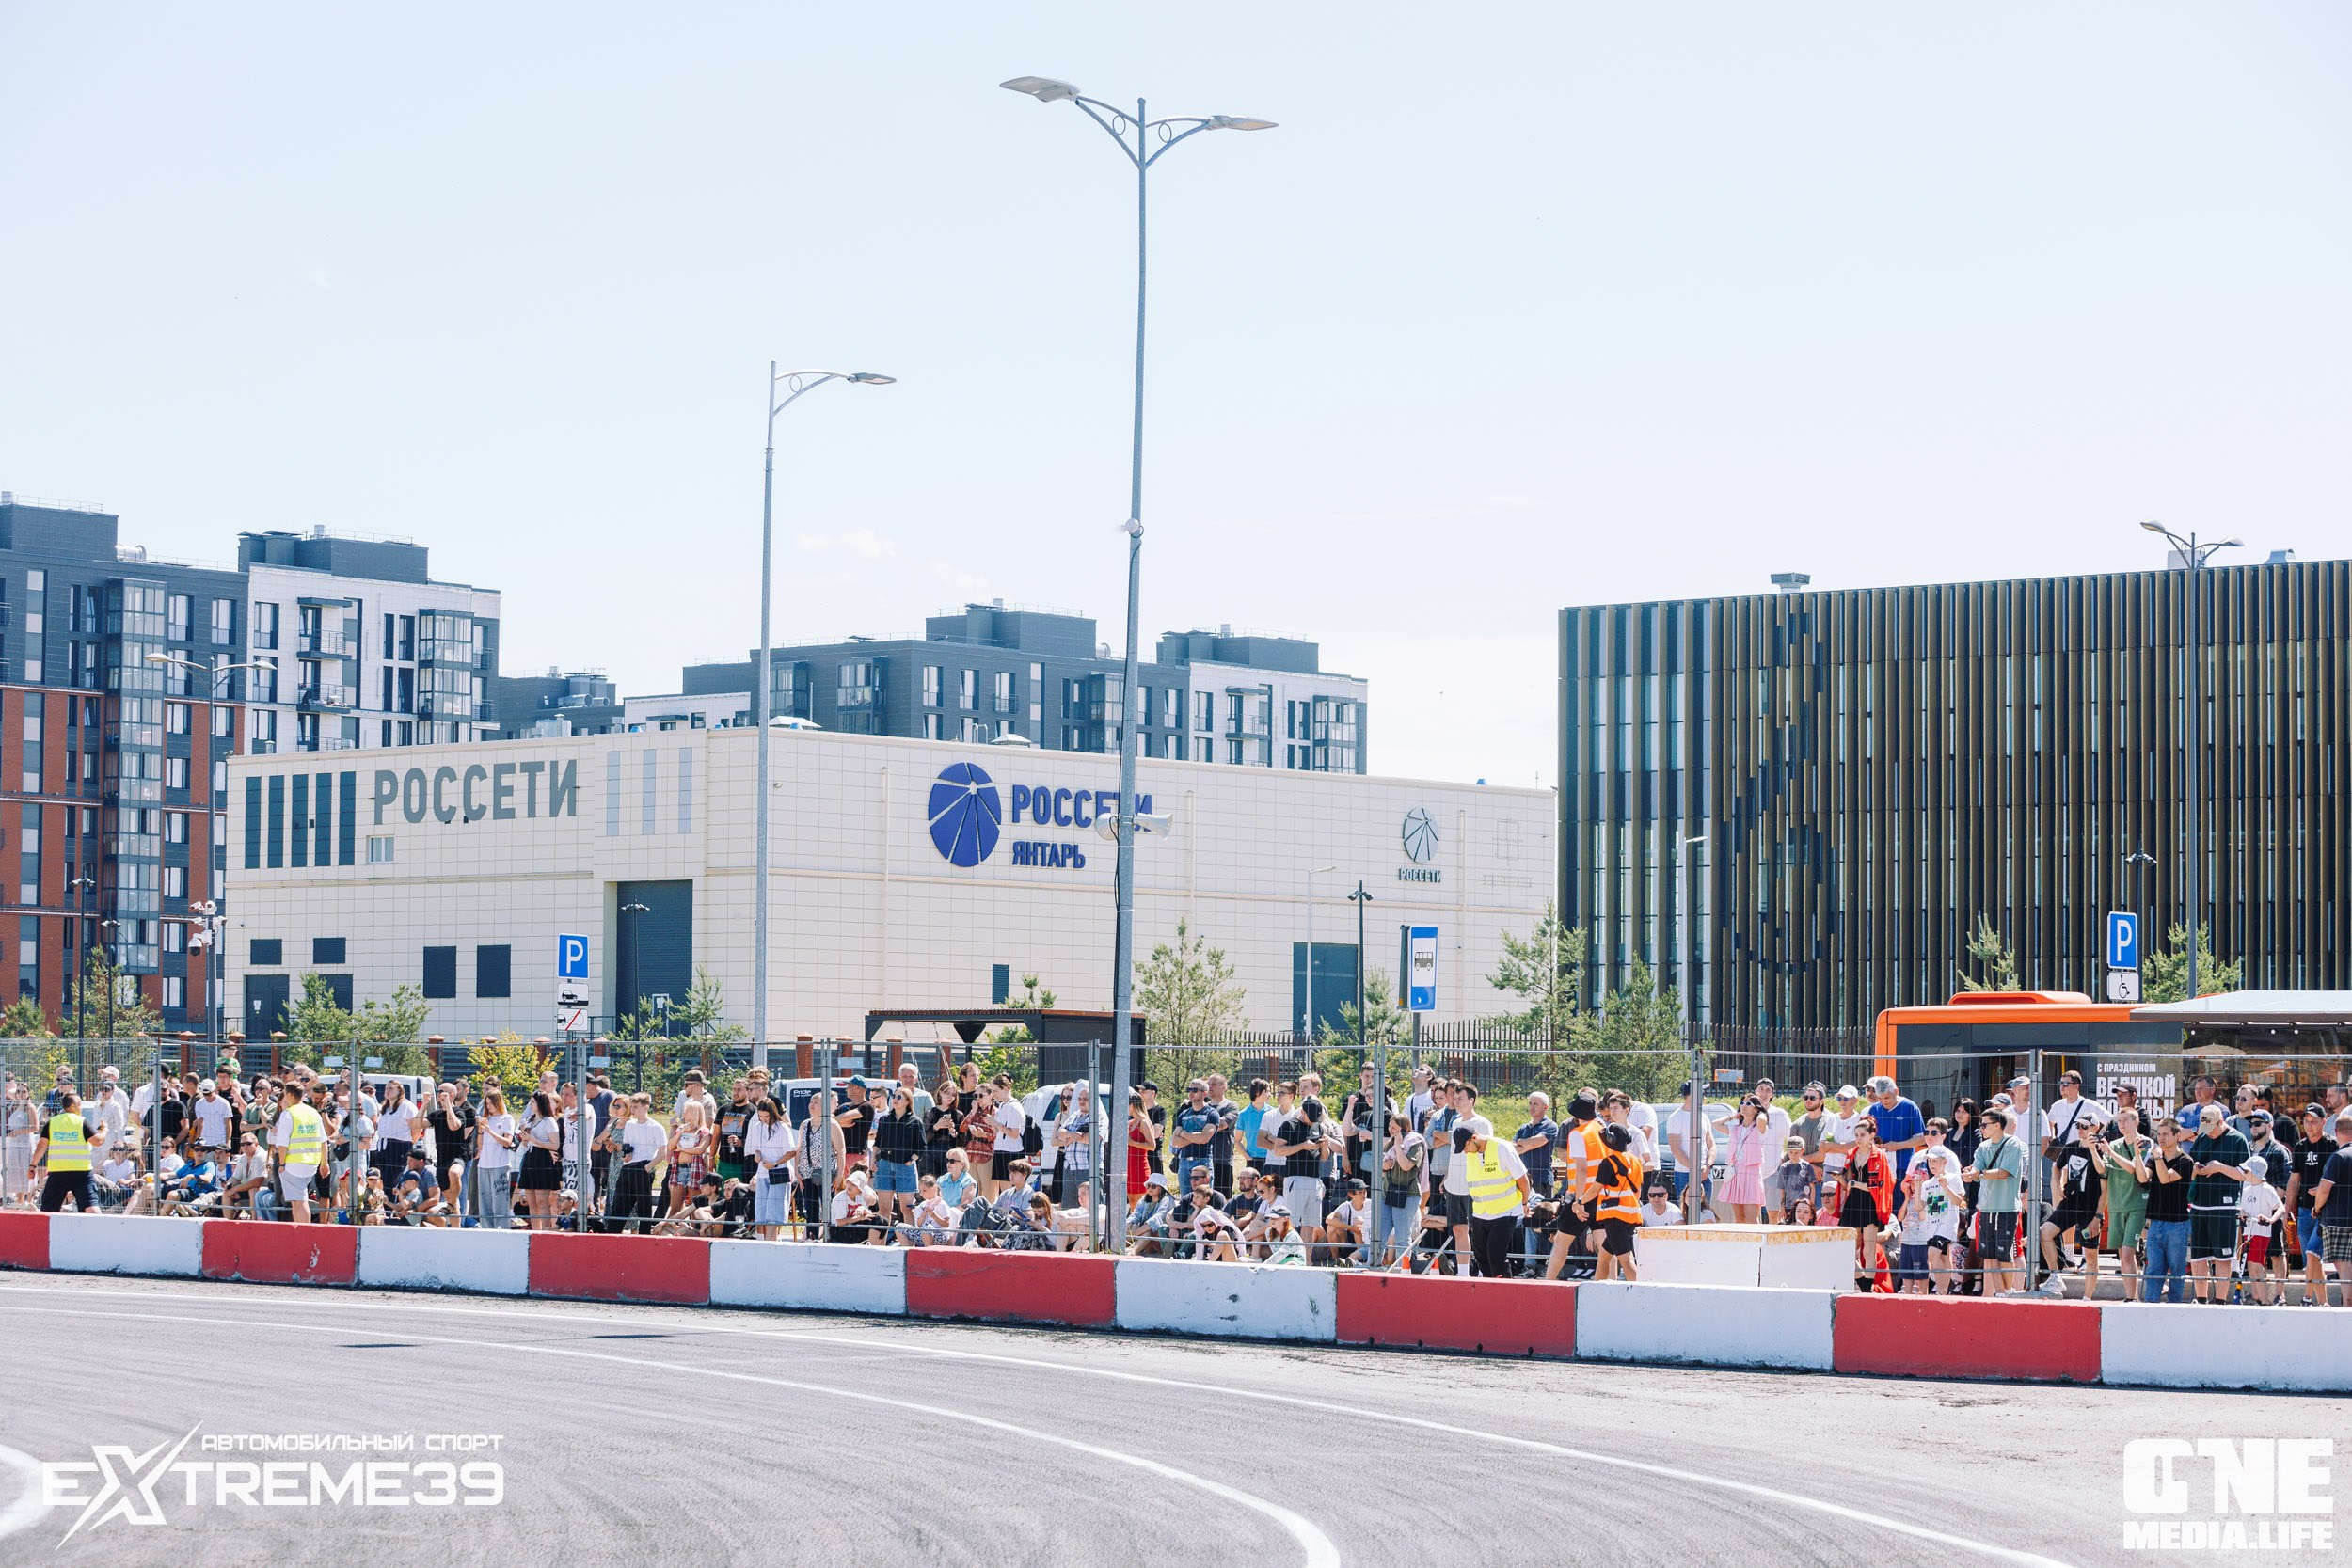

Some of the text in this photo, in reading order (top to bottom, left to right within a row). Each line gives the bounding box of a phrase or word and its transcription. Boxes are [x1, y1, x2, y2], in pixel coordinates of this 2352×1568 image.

[373, 760, 577, 824] РОССЕТИ
[1011, 841, 1087, 869] ЯНТАРЬ
[1399, 868, 1441, 882] РОССЕТИ
[2097, 1063, 2156, 1073] С ПРАЗДНИКОМ
